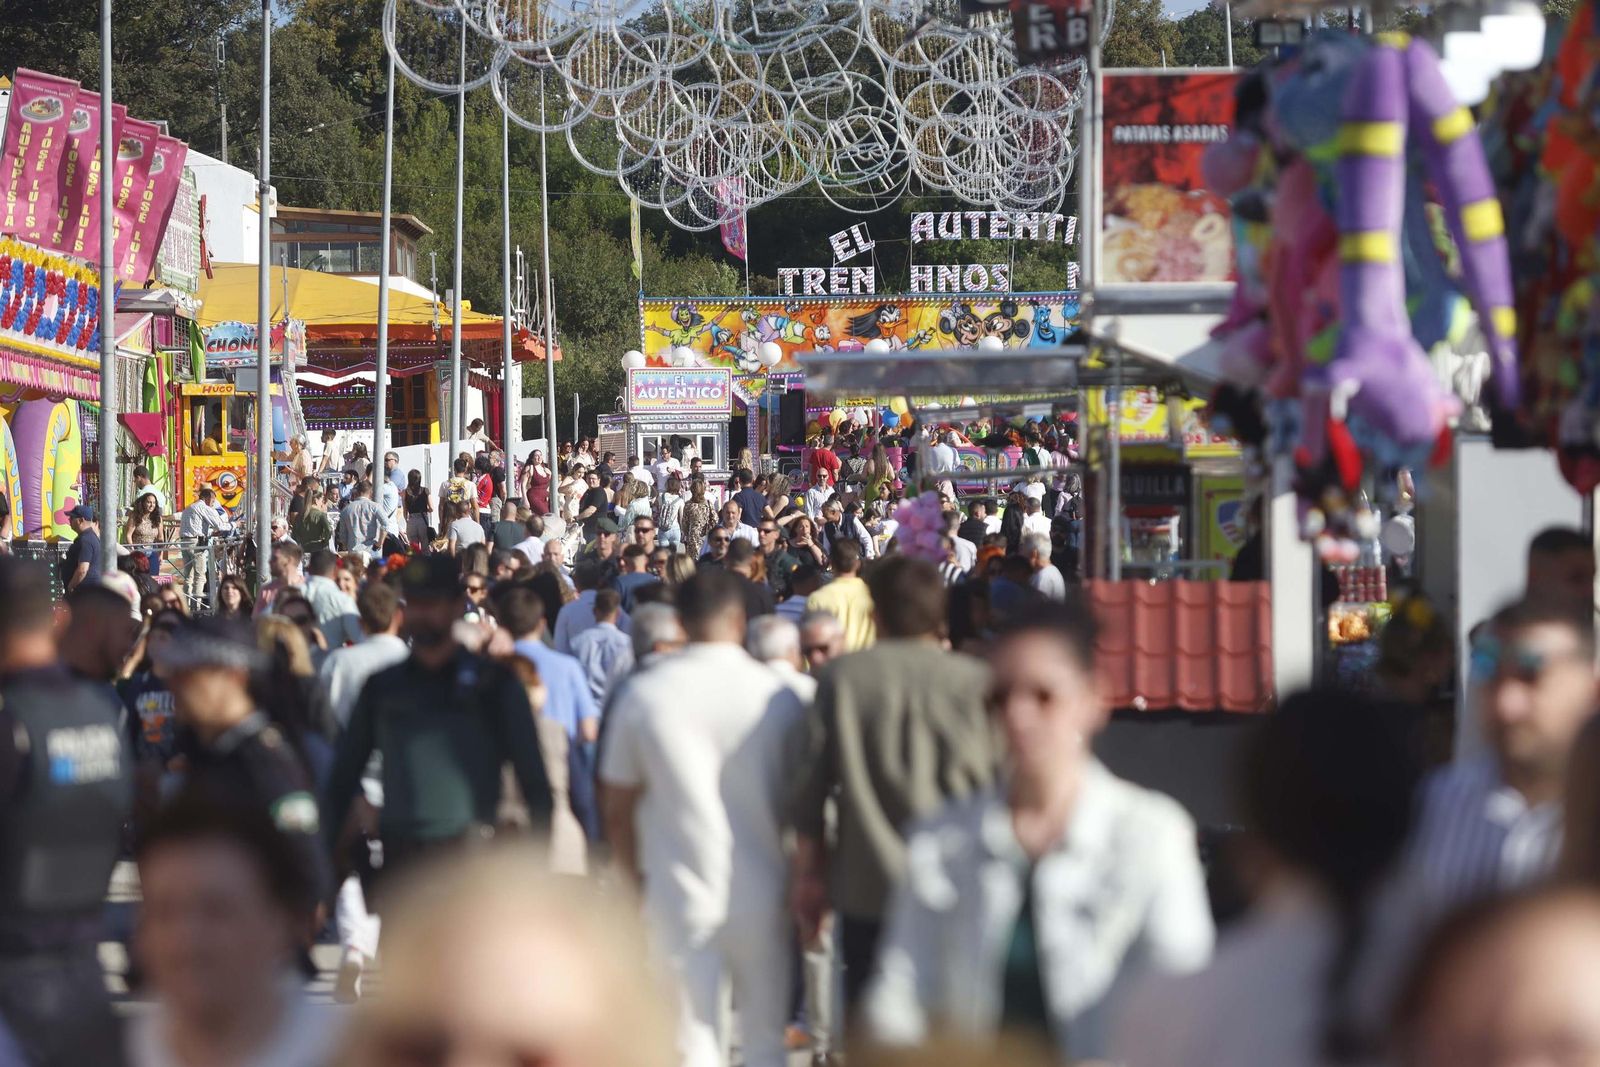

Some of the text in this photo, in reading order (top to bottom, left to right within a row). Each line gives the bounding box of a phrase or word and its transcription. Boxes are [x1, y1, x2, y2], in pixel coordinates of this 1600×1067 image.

[36, 126, 53, 171] JOSE
[1112, 125, 1228, 143] PATATAS ASADAS
[4, 122, 32, 227] AUTOPISTA
[52, 138, 79, 244] JOSE LUIS
[117, 165, 134, 209] JOSE
[25, 179, 39, 228] LUIS
[74, 149, 101, 252] JOSE LUIS
[125, 179, 155, 275] JOSE LUIS
[829, 221, 876, 263] EL
[911, 211, 1081, 245] AUTENTI
[778, 267, 875, 295] TREN
[910, 264, 1009, 293] HNOS
[638, 386, 722, 399] AUTENTICO
[674, 375, 687, 387] EL
